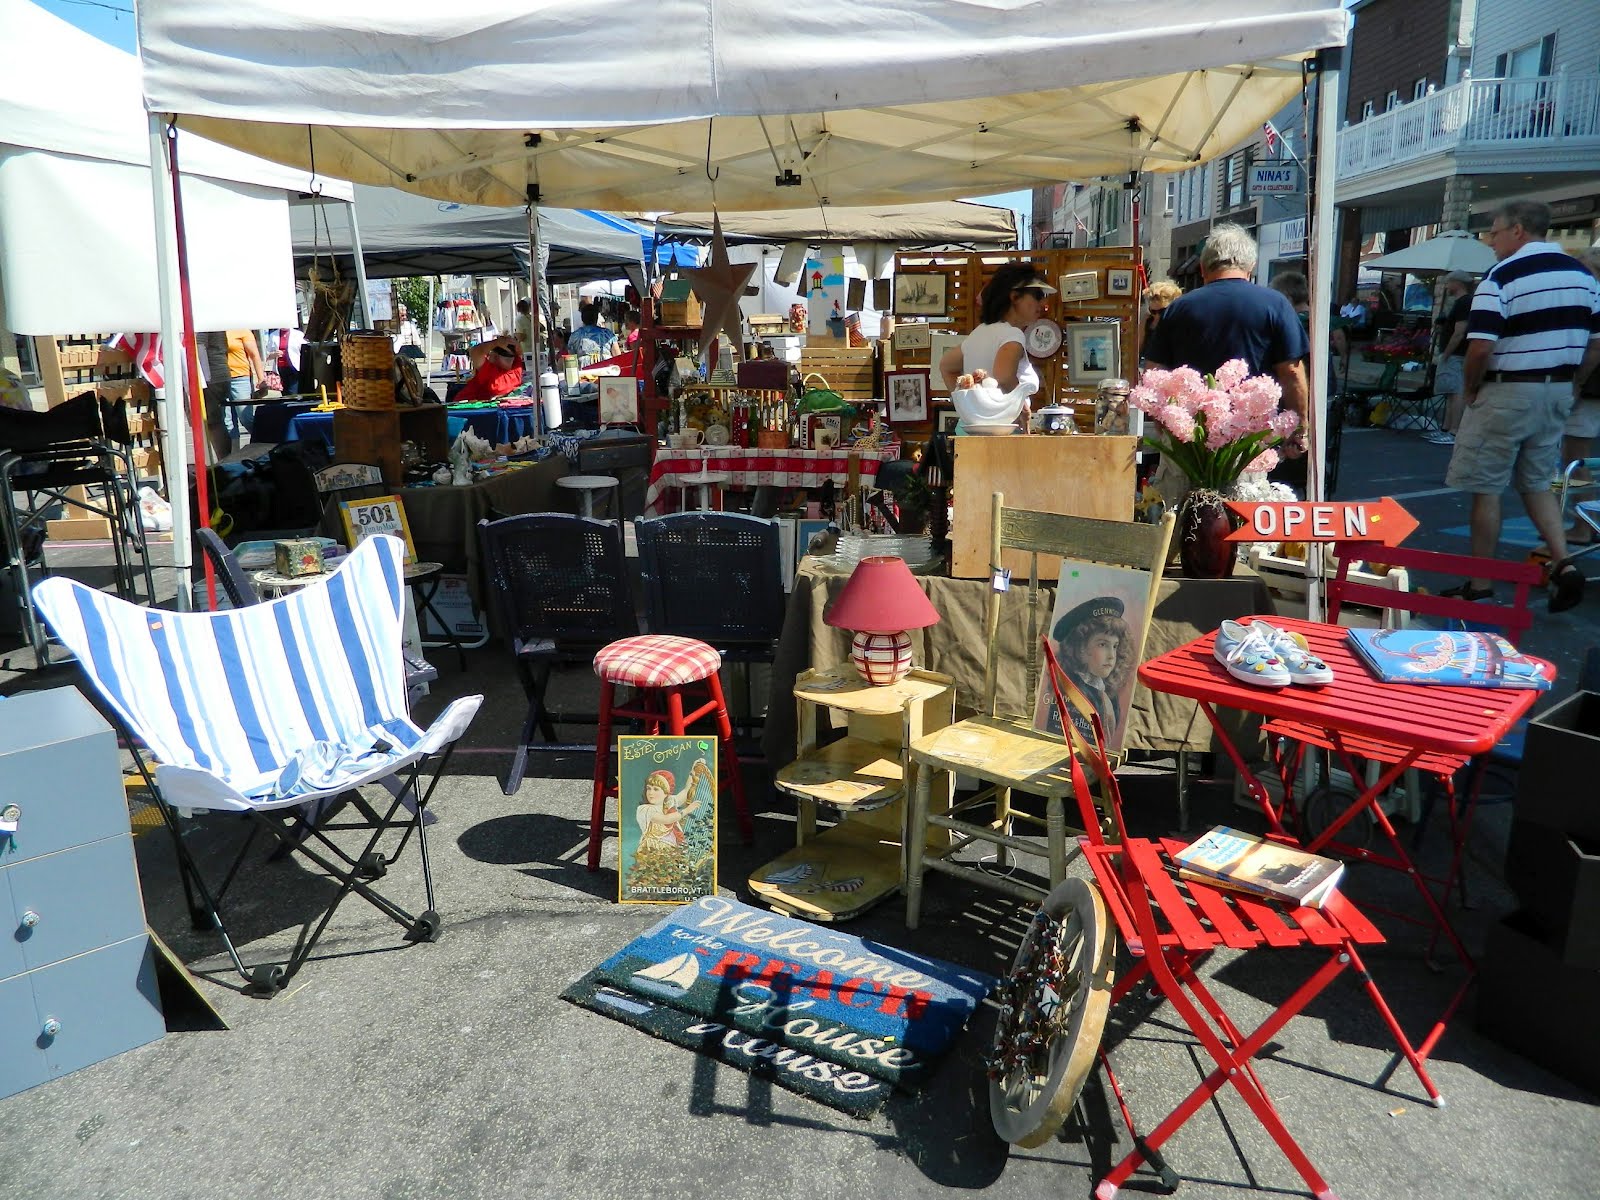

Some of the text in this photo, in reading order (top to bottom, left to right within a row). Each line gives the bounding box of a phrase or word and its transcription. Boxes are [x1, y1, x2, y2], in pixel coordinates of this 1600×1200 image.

[1256, 170, 1291, 182] NINA'S
[1284, 220, 1304, 240] NINA
[357, 504, 395, 526] 501
[1253, 504, 1367, 537] OPEN
[364, 525, 376, 533] Fun
[623, 738, 693, 764] ESTEY ORGAN
[698, 896, 932, 990] Welcome
[706, 948, 936, 1021] BEACH
[726, 981, 923, 1070] House
